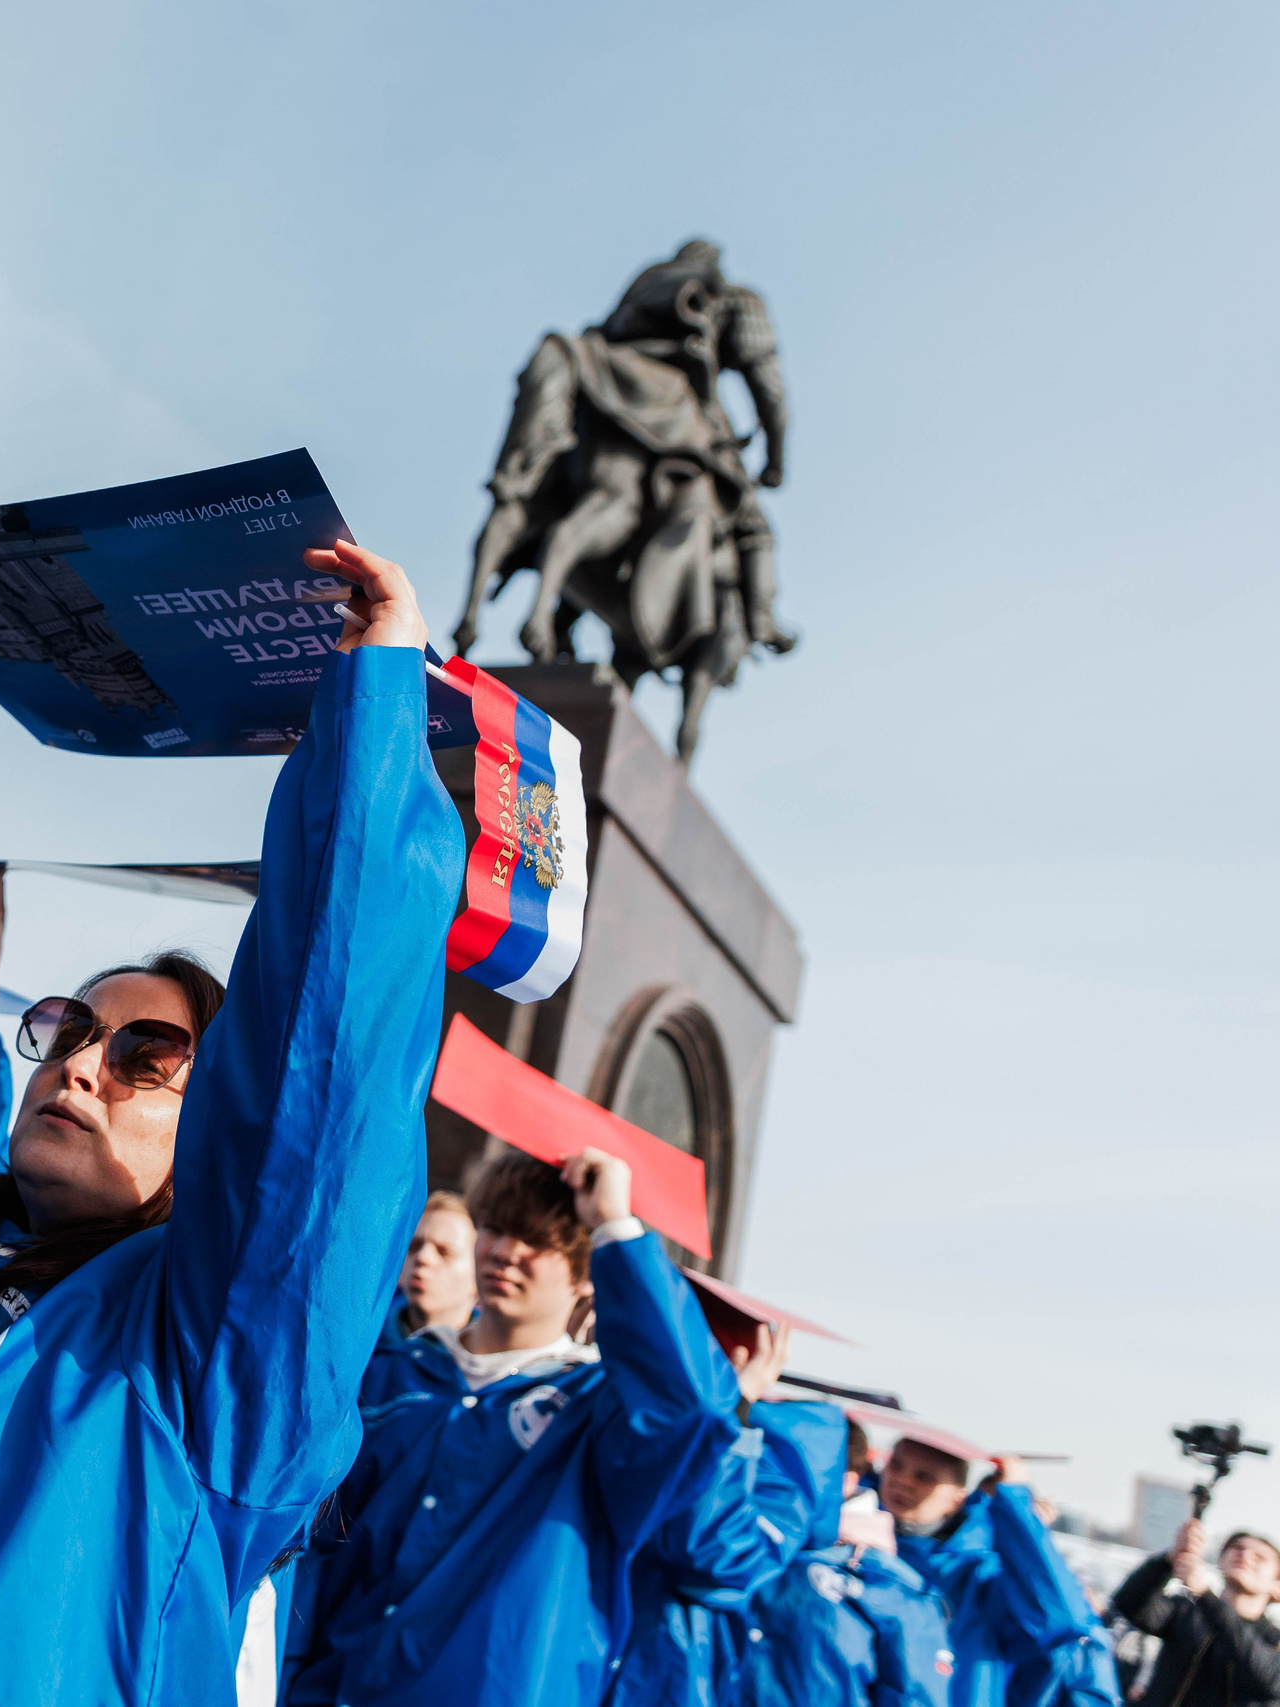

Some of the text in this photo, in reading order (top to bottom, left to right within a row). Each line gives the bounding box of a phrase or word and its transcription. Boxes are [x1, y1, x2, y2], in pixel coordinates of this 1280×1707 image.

[127, 488, 292, 529] В РОДНОЙ ГАВАНИ
[242, 511, 302, 534] 12 ЛЕТ
[133, 577, 346, 615] БУДУЩЕЕ!
[194, 601, 346, 639] ТРОИМ
[222, 633, 342, 663] МЕСТЕ
[251, 678, 286, 686] КРЫМА
[258, 669, 304, 679] РОССИЕЙ
[491, 738, 517, 890] РОССИЯ
